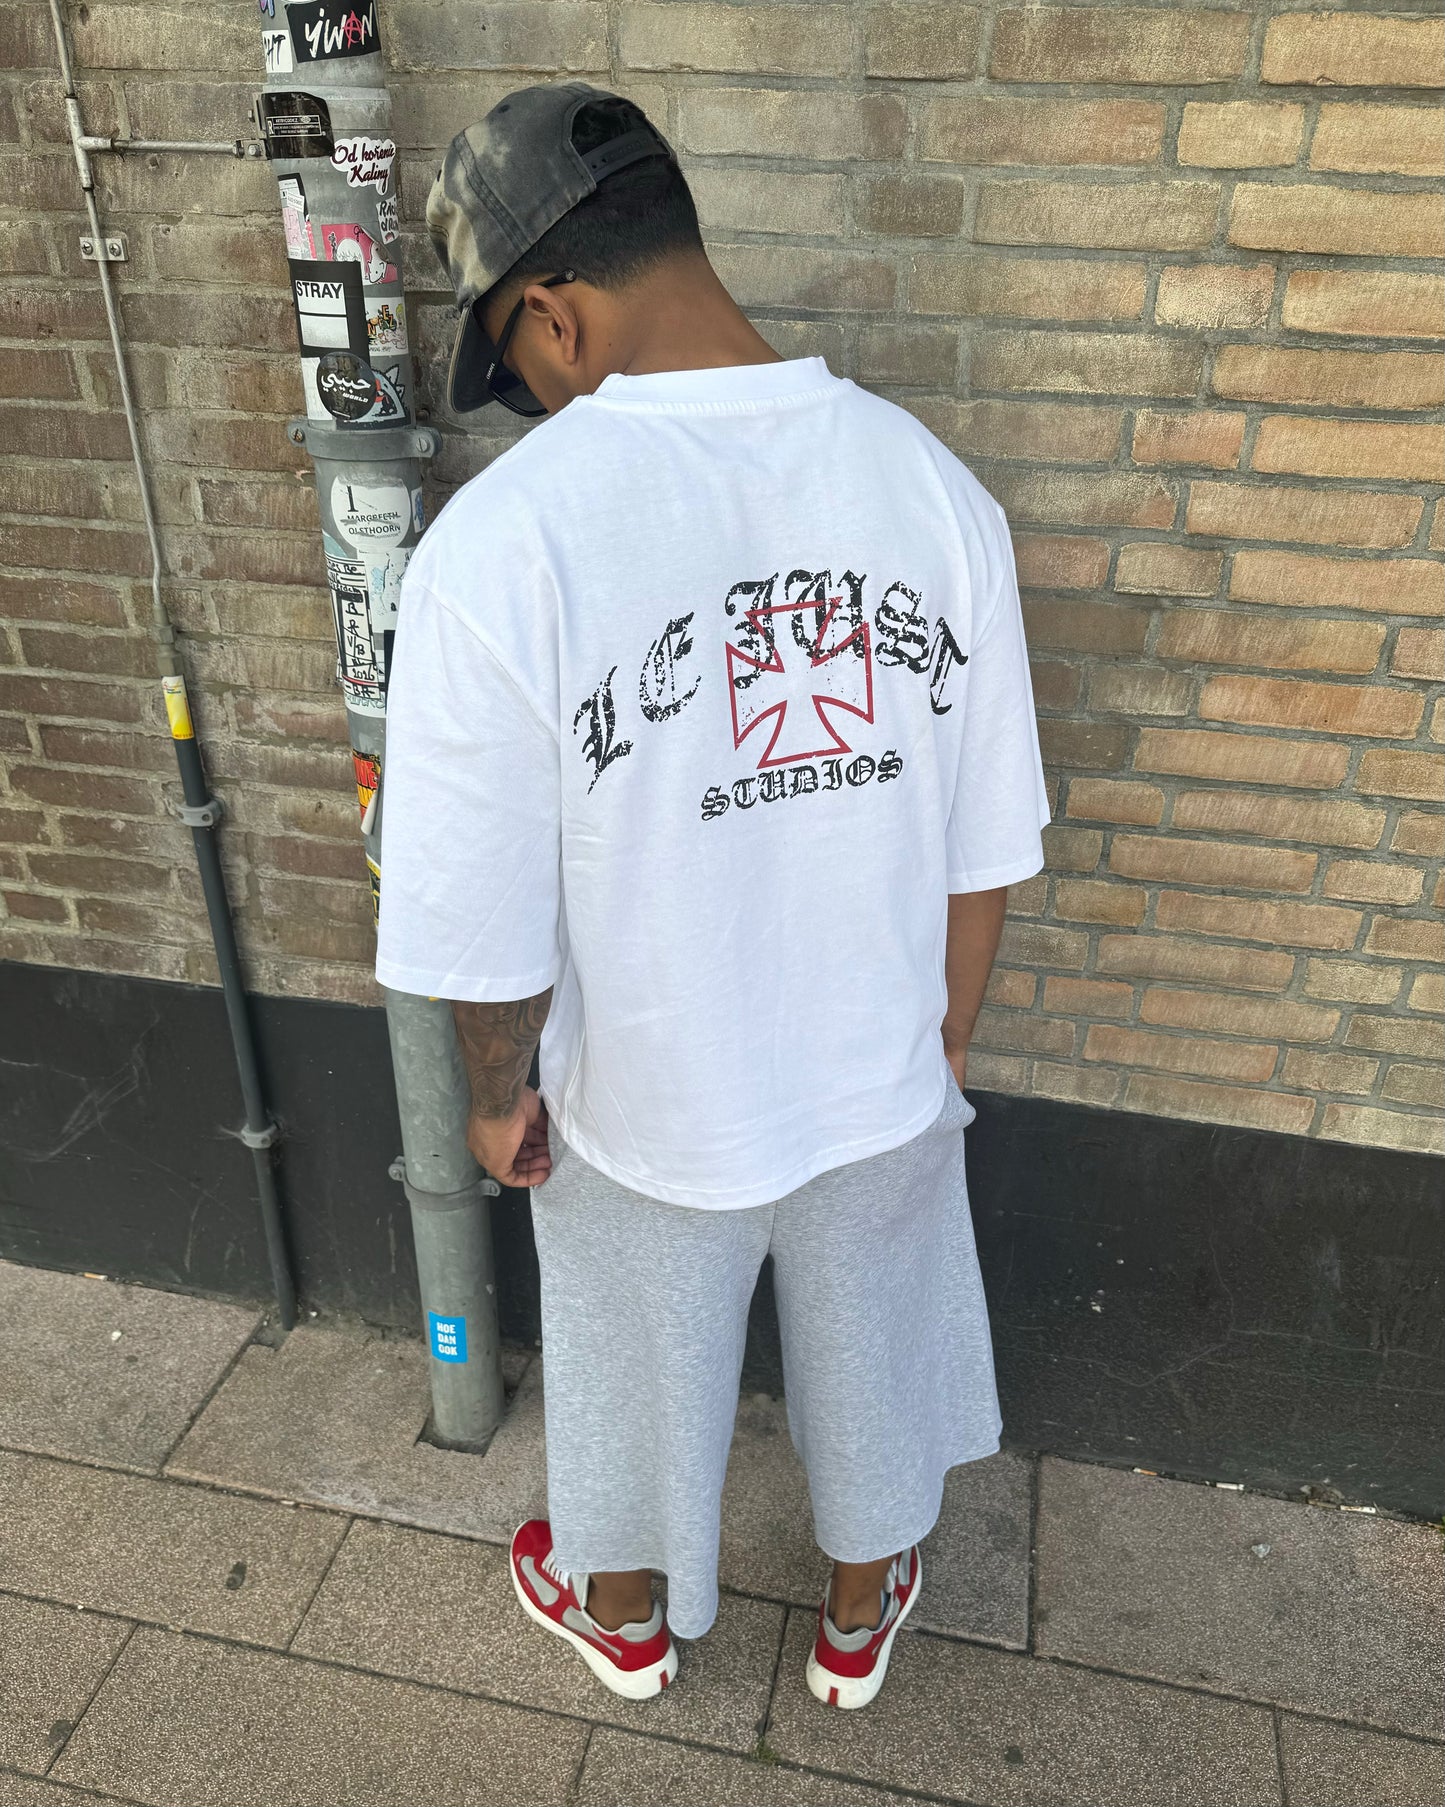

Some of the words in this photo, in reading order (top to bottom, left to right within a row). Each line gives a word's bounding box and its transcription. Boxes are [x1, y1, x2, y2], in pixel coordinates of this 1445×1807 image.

[332, 144, 358, 164] Od
[350, 162, 388, 193] Kaliny
[296, 281, 342, 299] STRAY
[321, 373, 371, 393] حبيبي
[725, 568, 969, 716] JUST
[701, 749, 903, 821] STUDIOS
[436, 1322, 456, 1334] HOE
[437, 1333, 456, 1345] DAN
